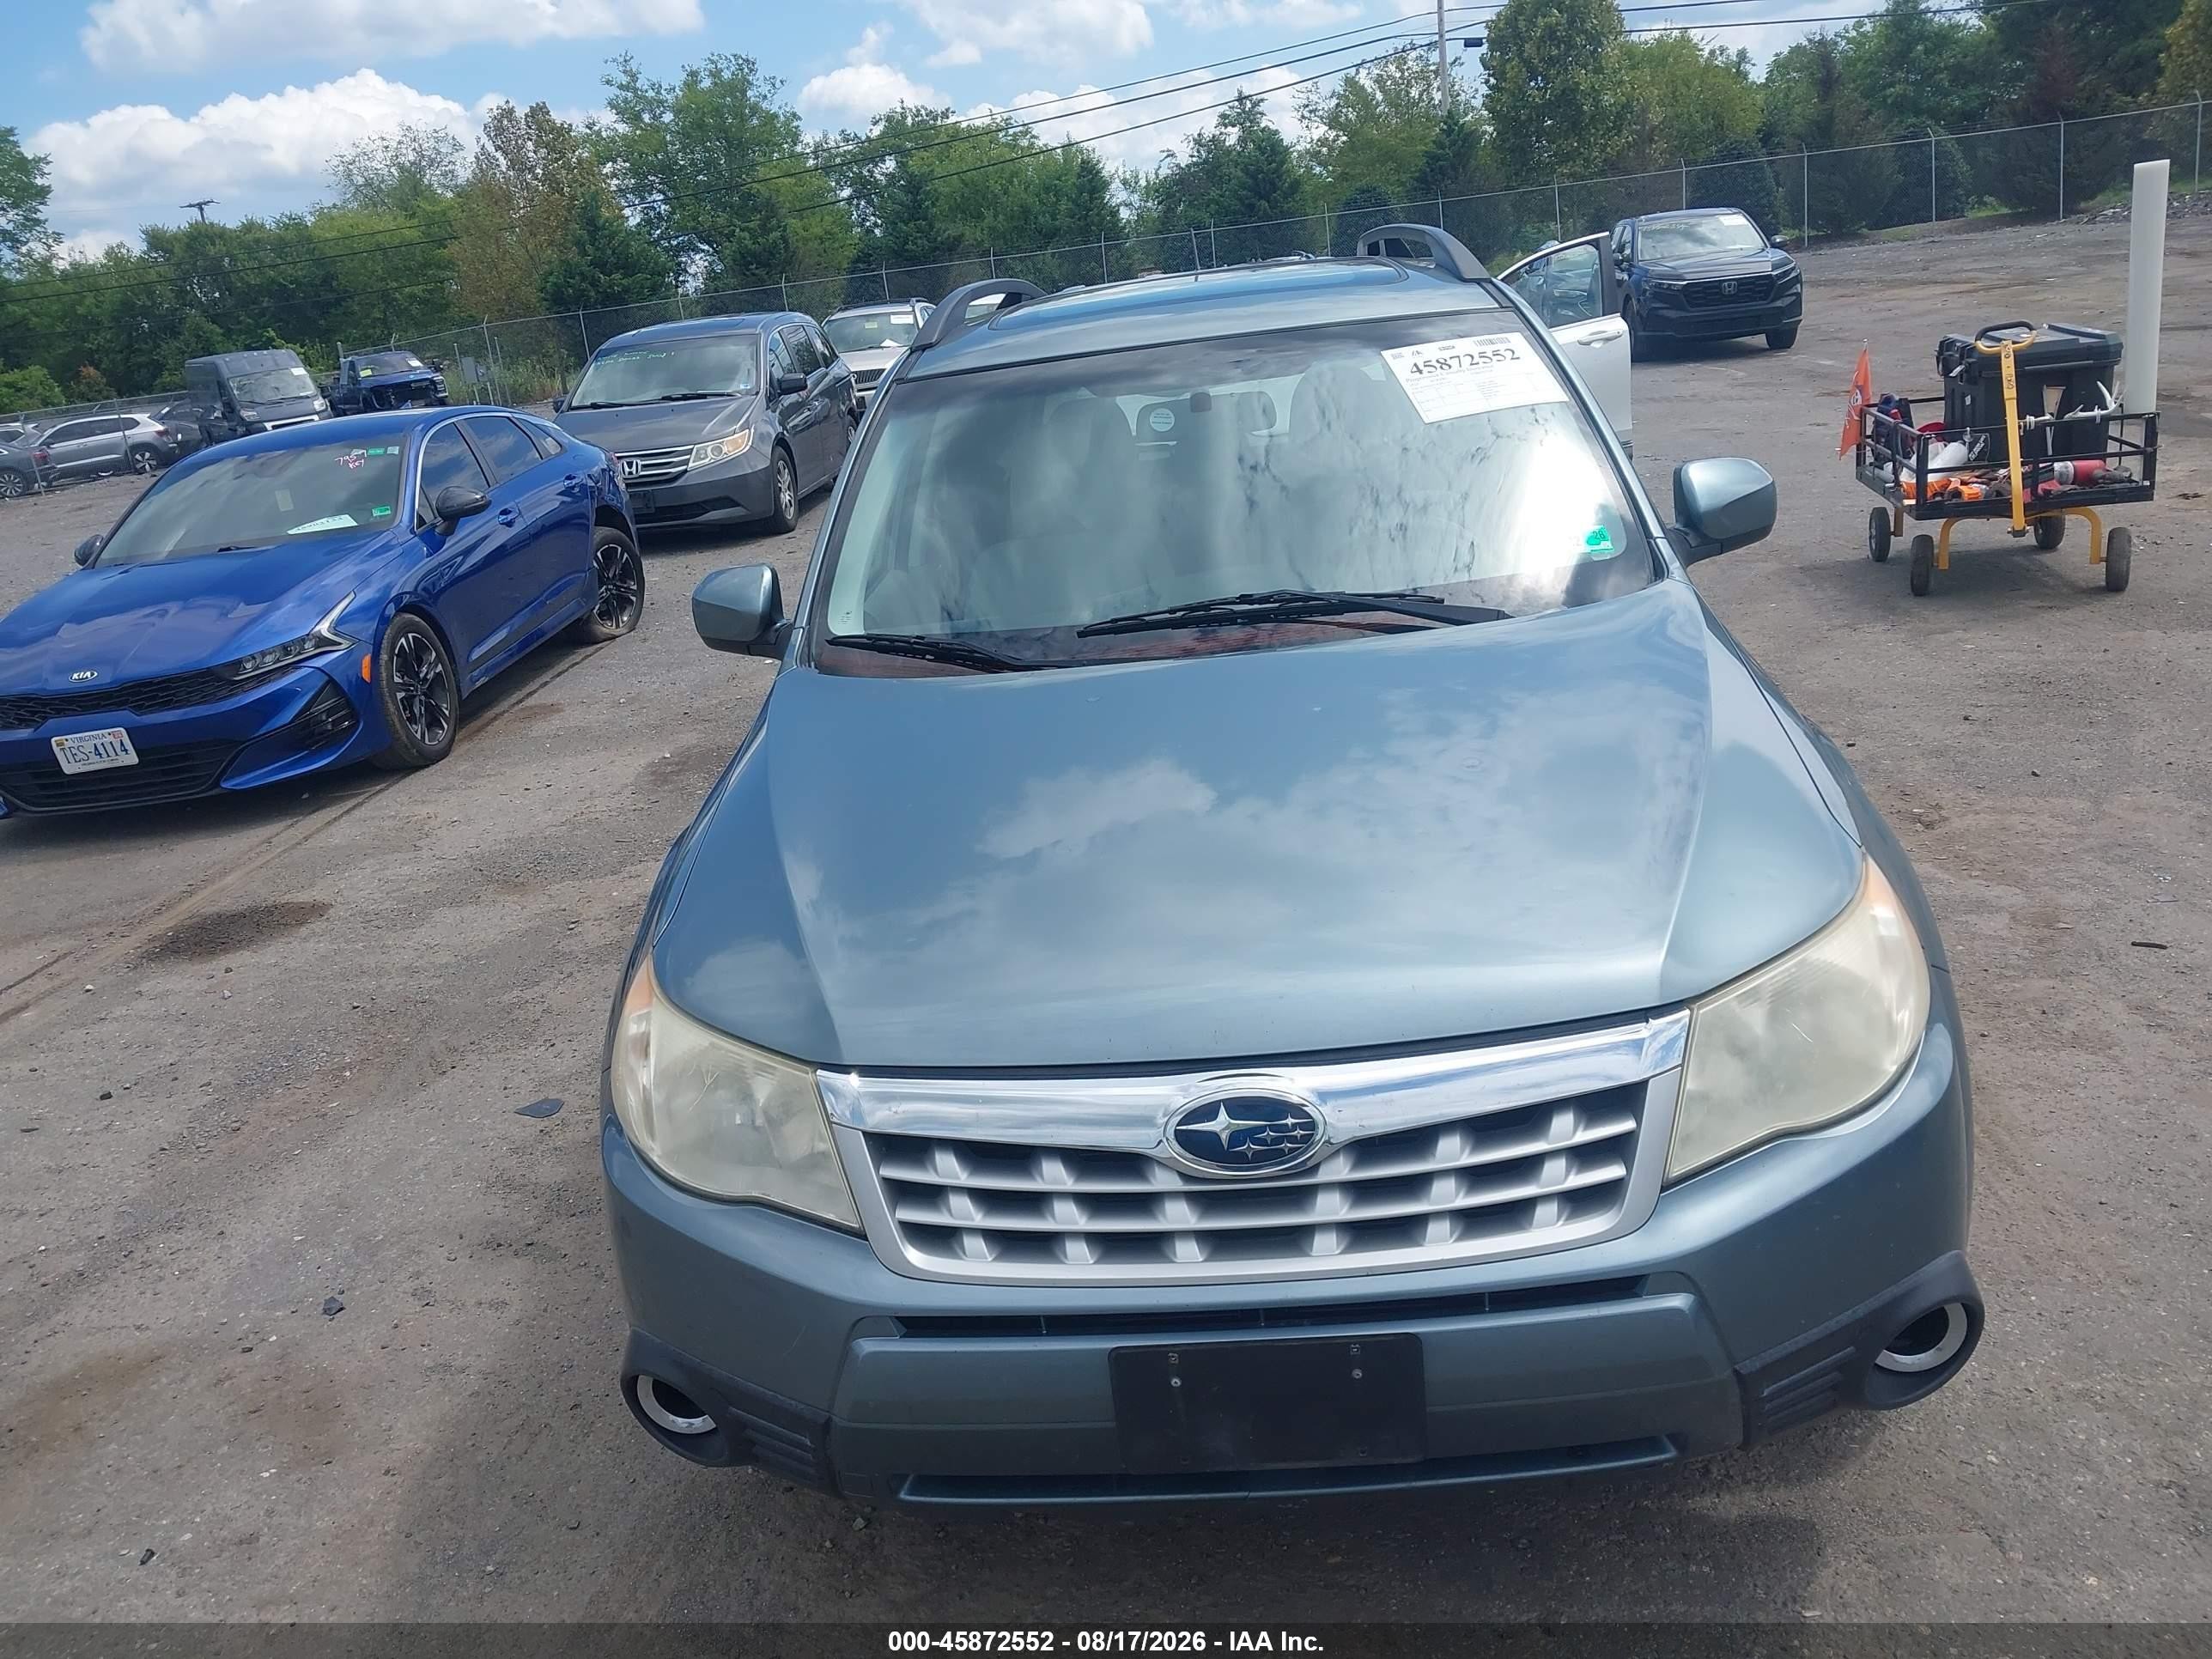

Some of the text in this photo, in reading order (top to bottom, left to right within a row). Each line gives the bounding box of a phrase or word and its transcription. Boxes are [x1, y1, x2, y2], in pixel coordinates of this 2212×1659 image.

[1410, 349, 1520, 374] 45872552
[71, 672, 91, 680] KIA
[70, 732, 107, 744] VIRGINIA
[59, 739, 130, 764] TES-4114
